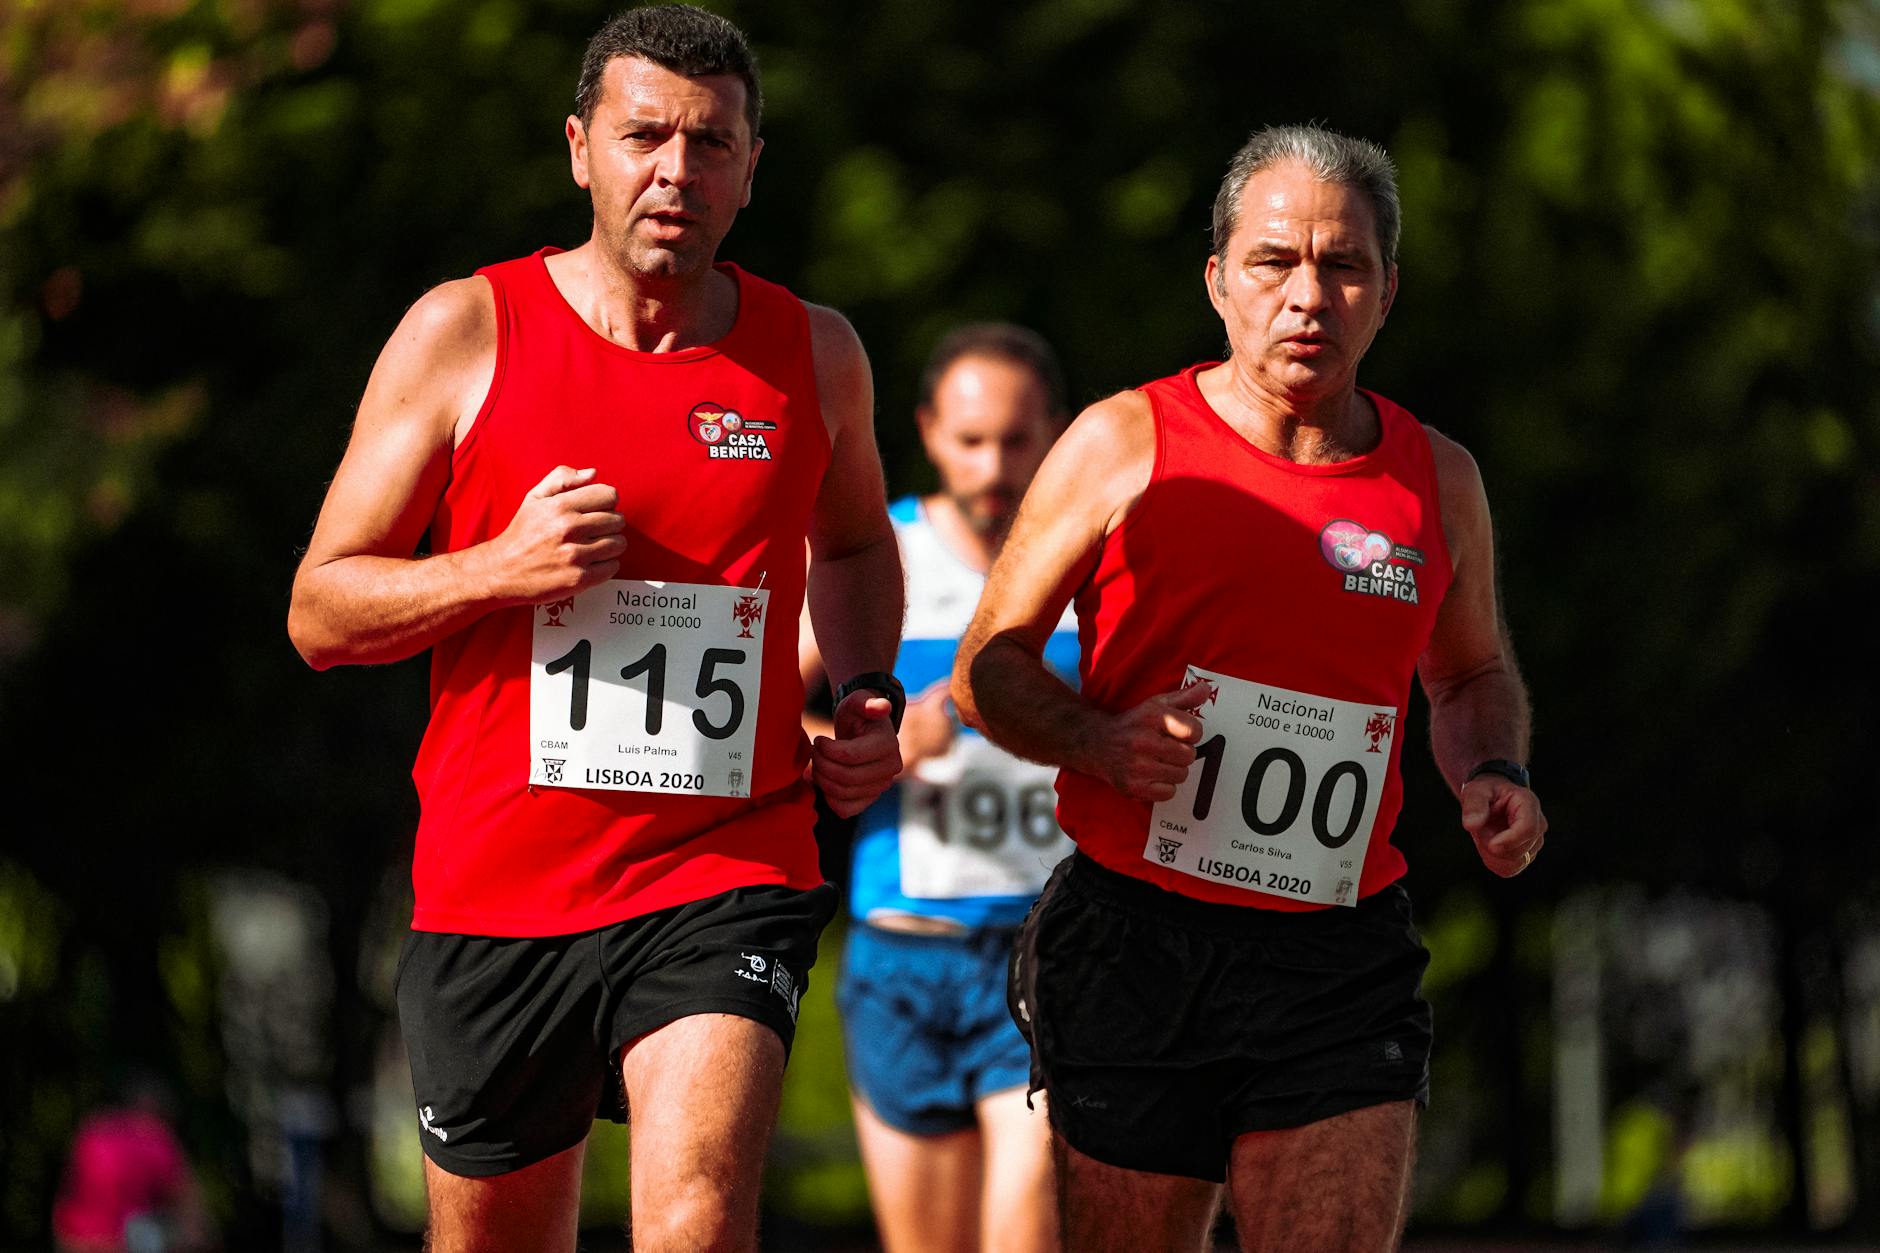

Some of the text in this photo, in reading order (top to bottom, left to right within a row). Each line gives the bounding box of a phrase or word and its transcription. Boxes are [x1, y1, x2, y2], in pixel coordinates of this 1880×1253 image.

[729, 434, 766, 447] CASA
[710, 446, 771, 459] BENFICA
[1371, 562, 1415, 586] CASA
[617, 590, 696, 610] Nacional
[1345, 575, 1418, 604] BENFICA
[609, 612, 701, 629] 5000 e 10000
[545, 639, 747, 740] 115
[1257, 692, 1335, 723] Nacional
[1247, 713, 1335, 742] 5000 e 10000
[540, 740, 569, 750] CBAM
[643, 745, 677, 757] Palma
[728, 751, 742, 761] V45
[585, 768, 705, 790] LISBOA 2020
[1192, 733, 1368, 849] 100
[918, 781, 1059, 850] 196
[1159, 820, 1188, 835] CBAM
[1231, 839, 1292, 861] Carlos Silva
[1197, 856, 1312, 895] LISBOA 2020
